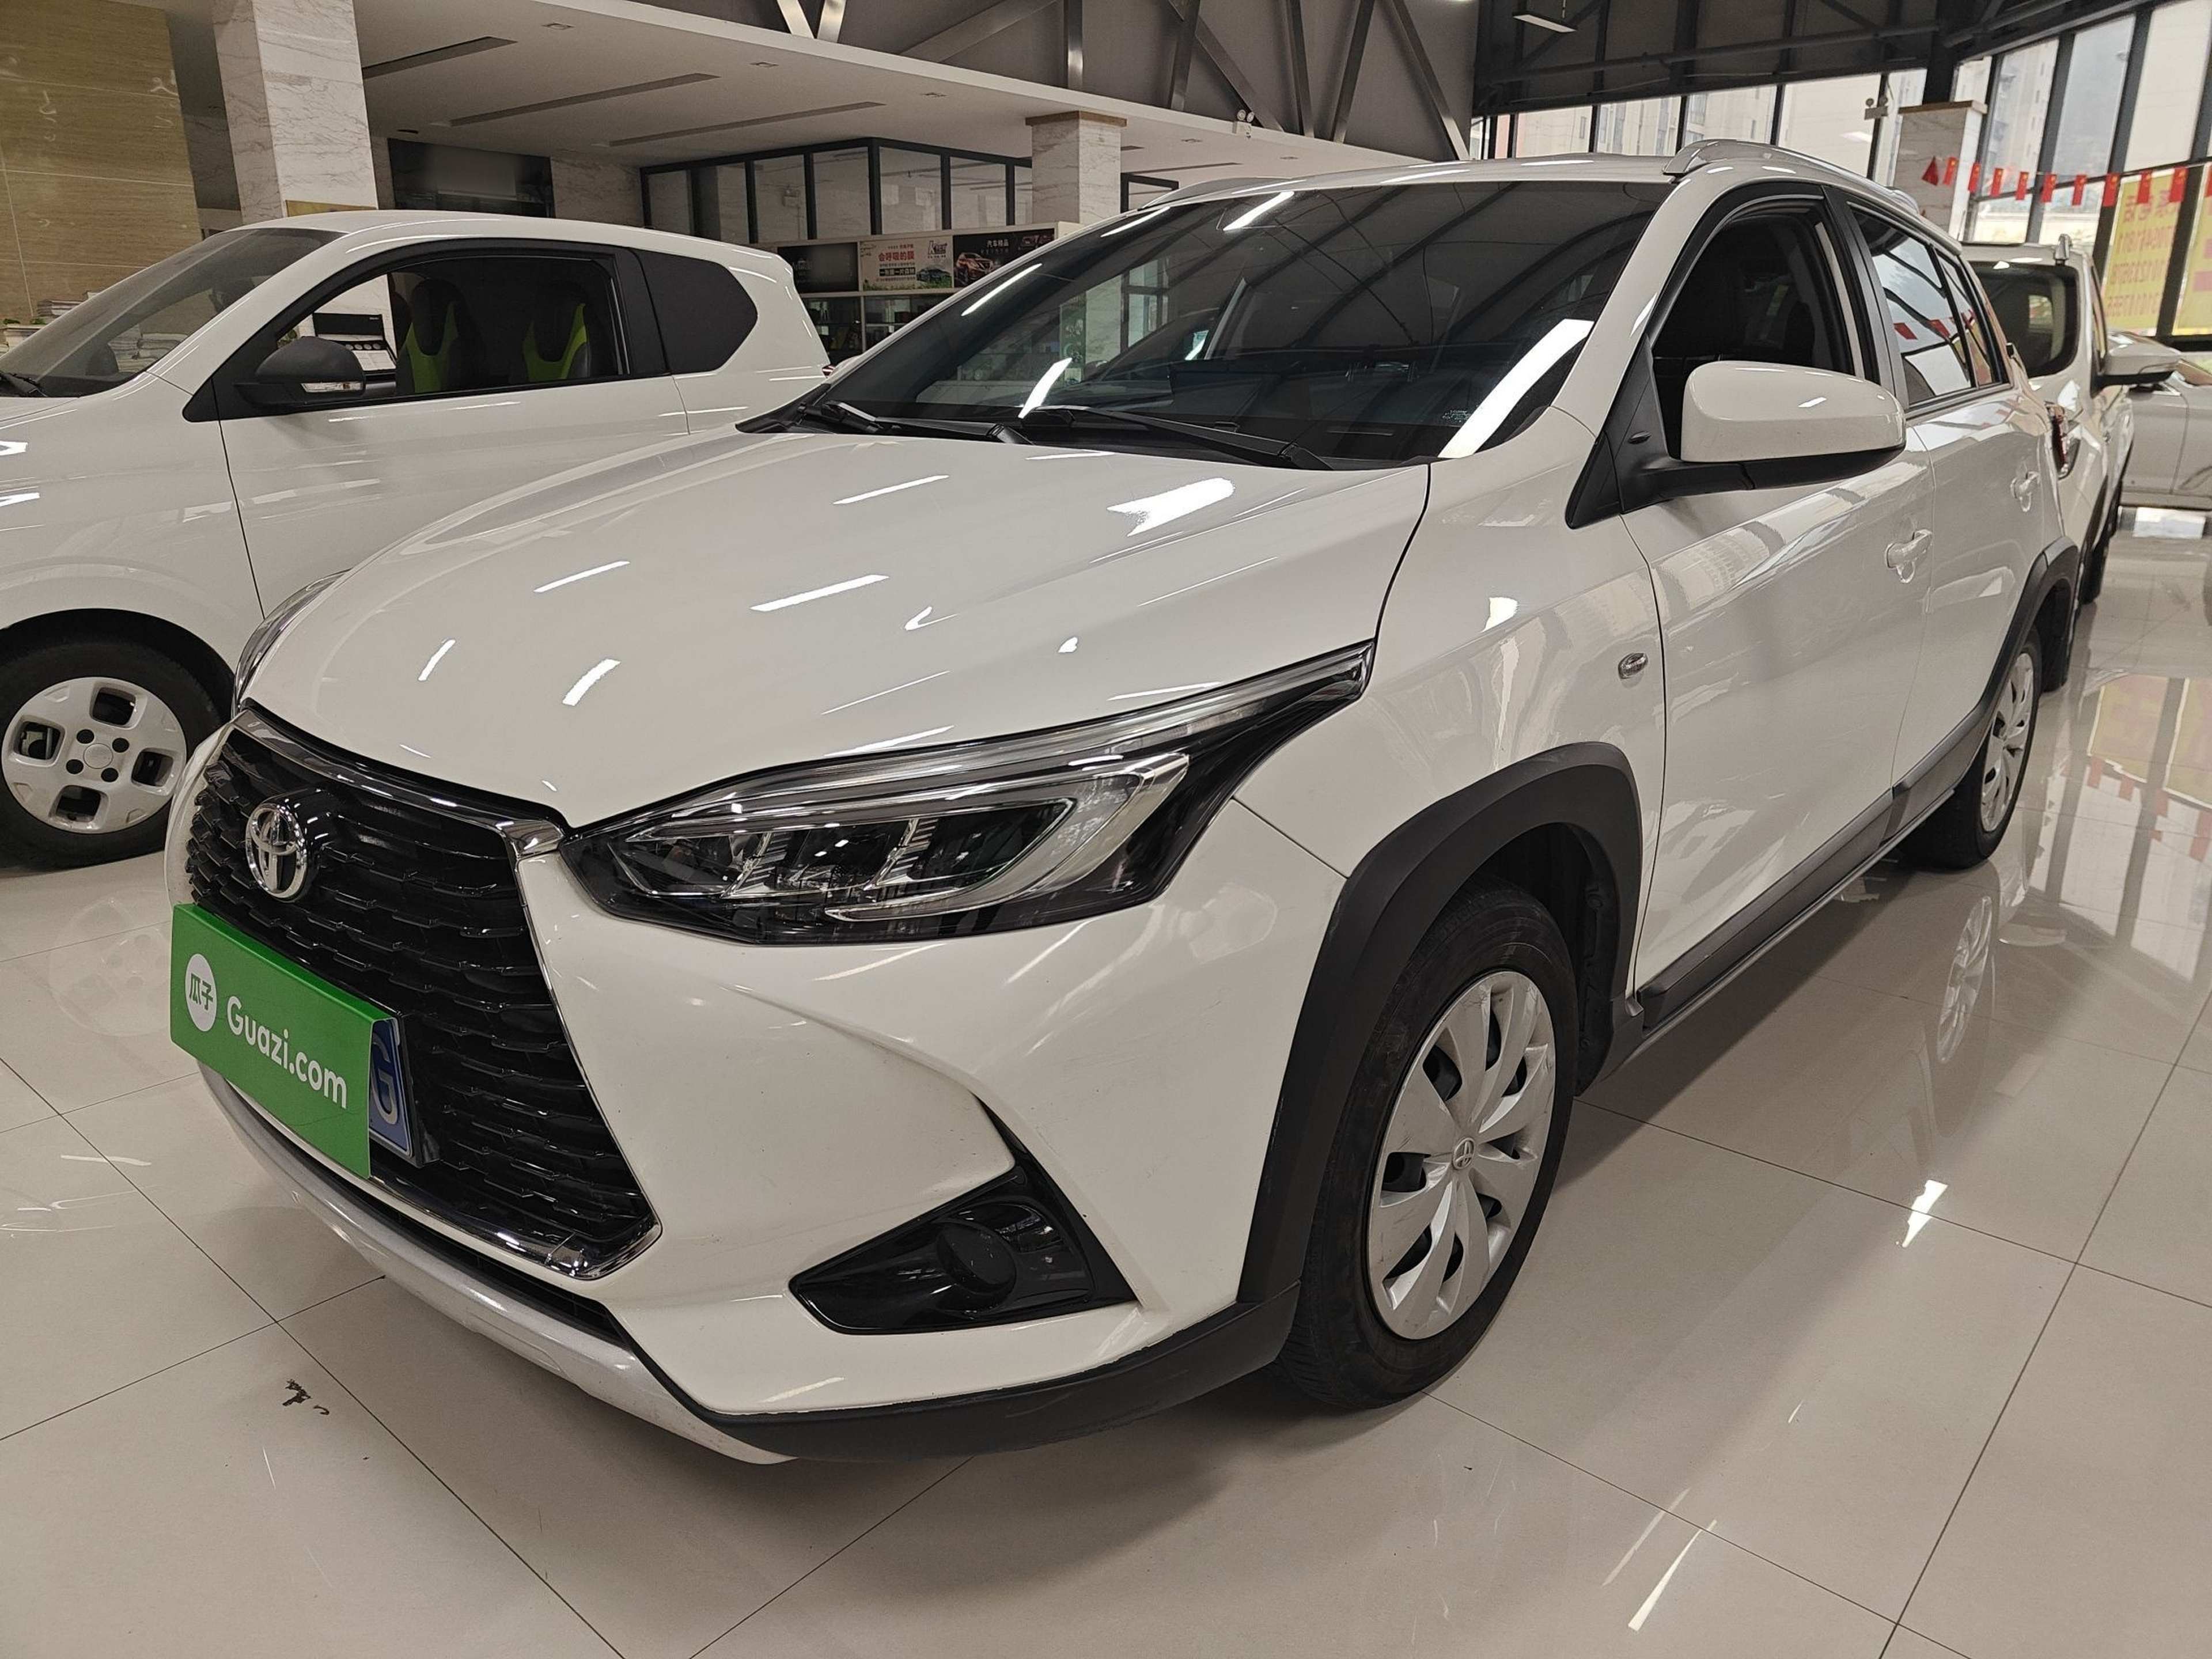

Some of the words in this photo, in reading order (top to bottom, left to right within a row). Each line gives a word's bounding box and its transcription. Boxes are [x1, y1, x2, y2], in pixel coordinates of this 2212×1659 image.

[878, 251, 914, 262] 会呼吸的膜
[190, 973, 213, 1010] 瓜子
[227, 996, 346, 1109] Guazi.com
